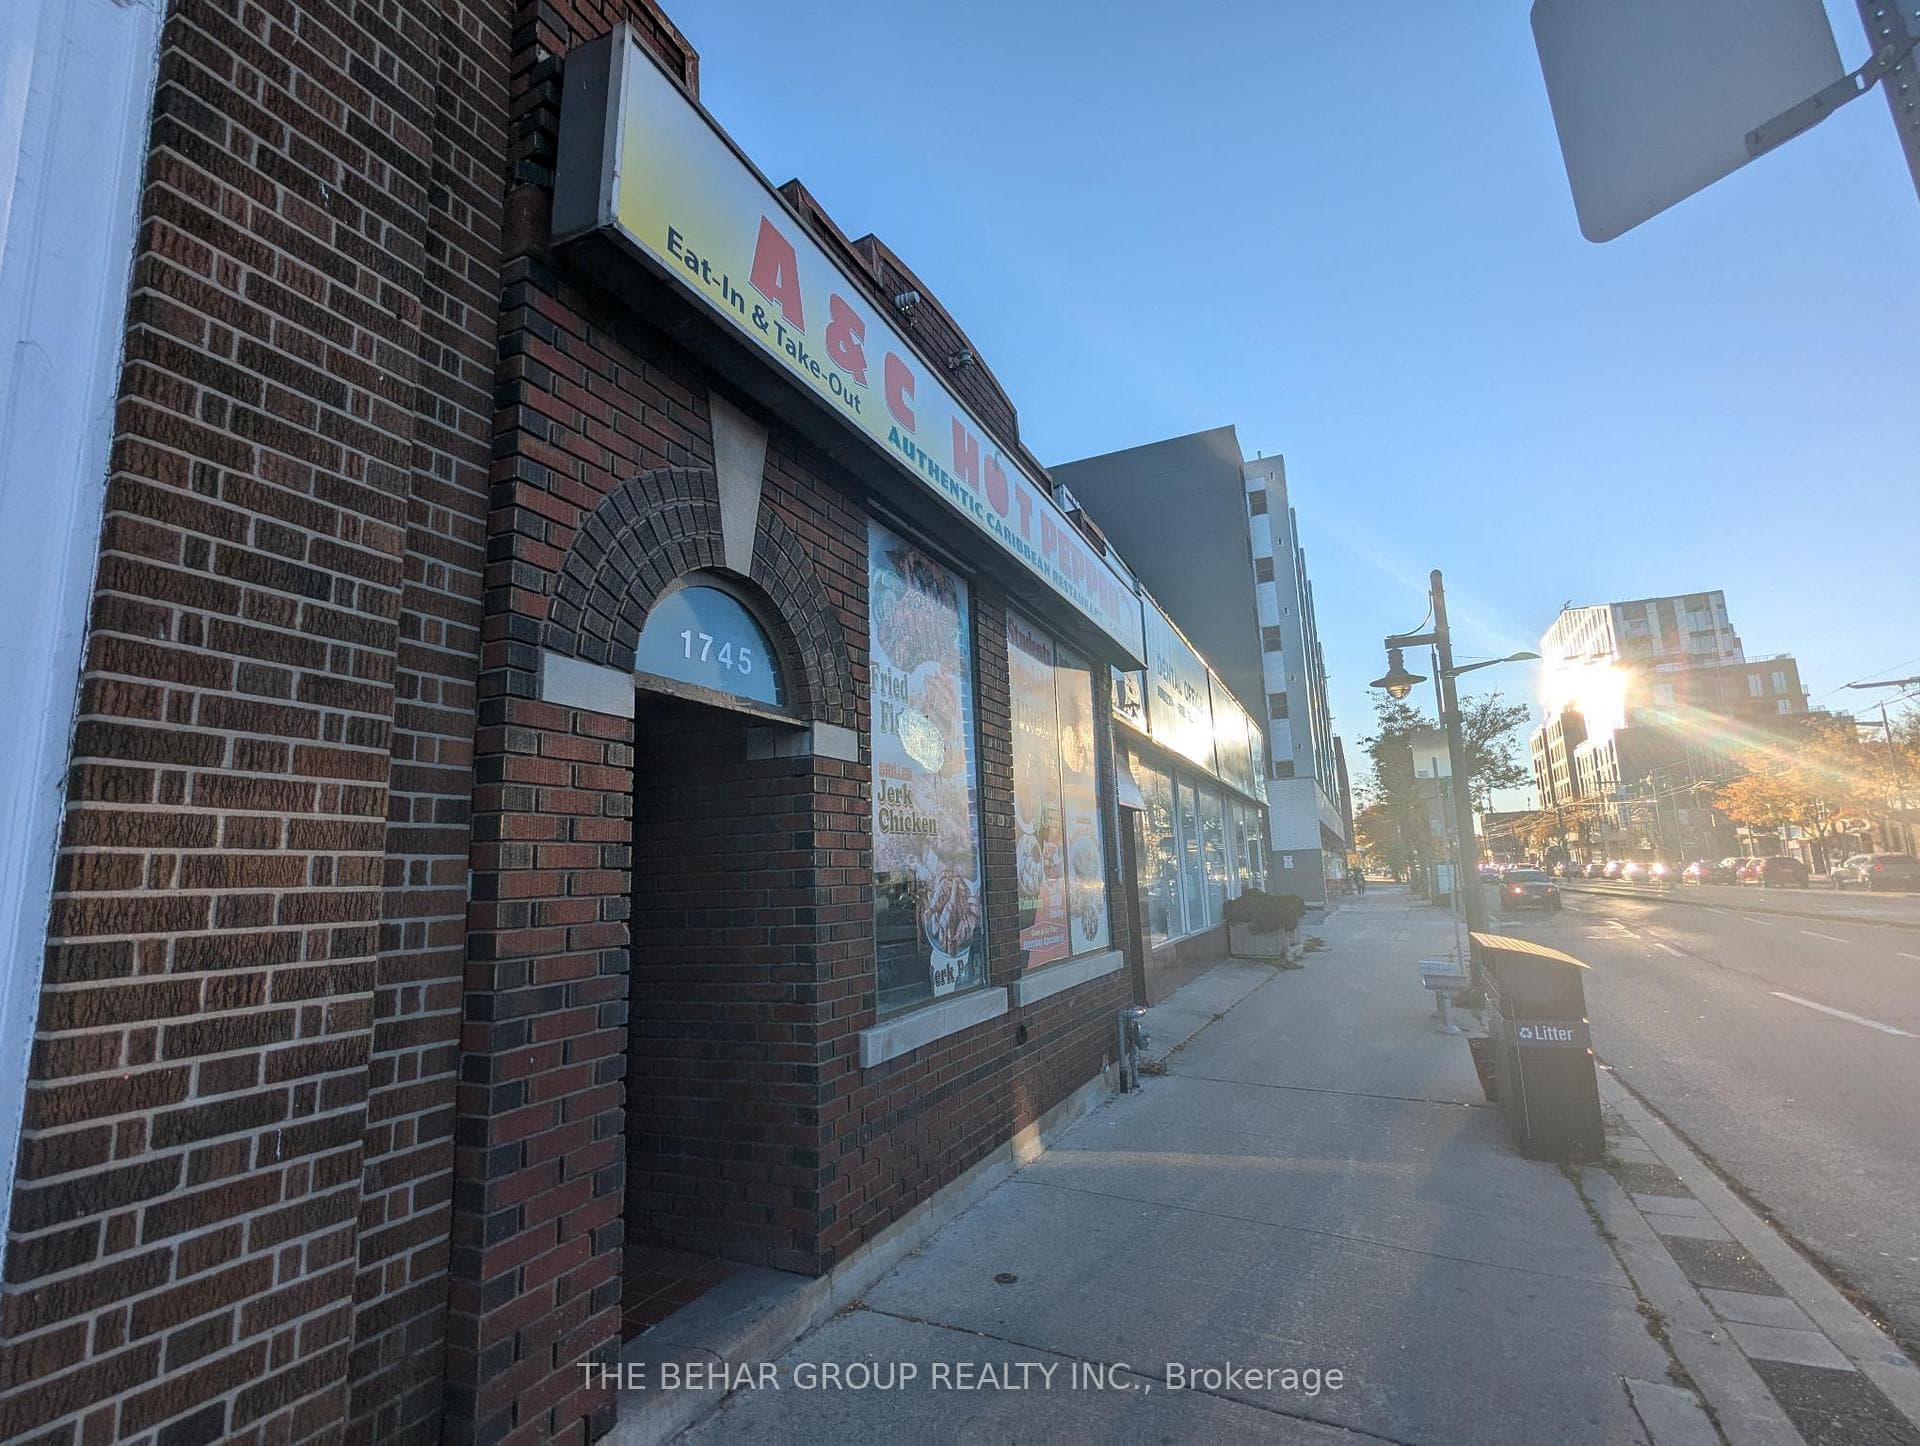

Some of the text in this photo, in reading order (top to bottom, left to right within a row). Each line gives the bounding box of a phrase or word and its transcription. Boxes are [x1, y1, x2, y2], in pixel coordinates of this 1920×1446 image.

[666, 224, 862, 415] Eat-In & Take-Out
[748, 214, 806, 335] A
[825, 293, 869, 389] &
[884, 350, 916, 435] C
[951, 416, 1034, 543] HOT
[888, 425, 985, 521] AUTHENTIC
[986, 512, 1051, 577] CARIBBEAN
[680, 629, 752, 675] 1745
[871, 659, 909, 705] Fried
[880, 699, 906, 737] Fi
[877, 779, 914, 808] Jerk
[879, 808, 938, 836] Chicken
[1534, 1025, 1573, 1040] Litter
